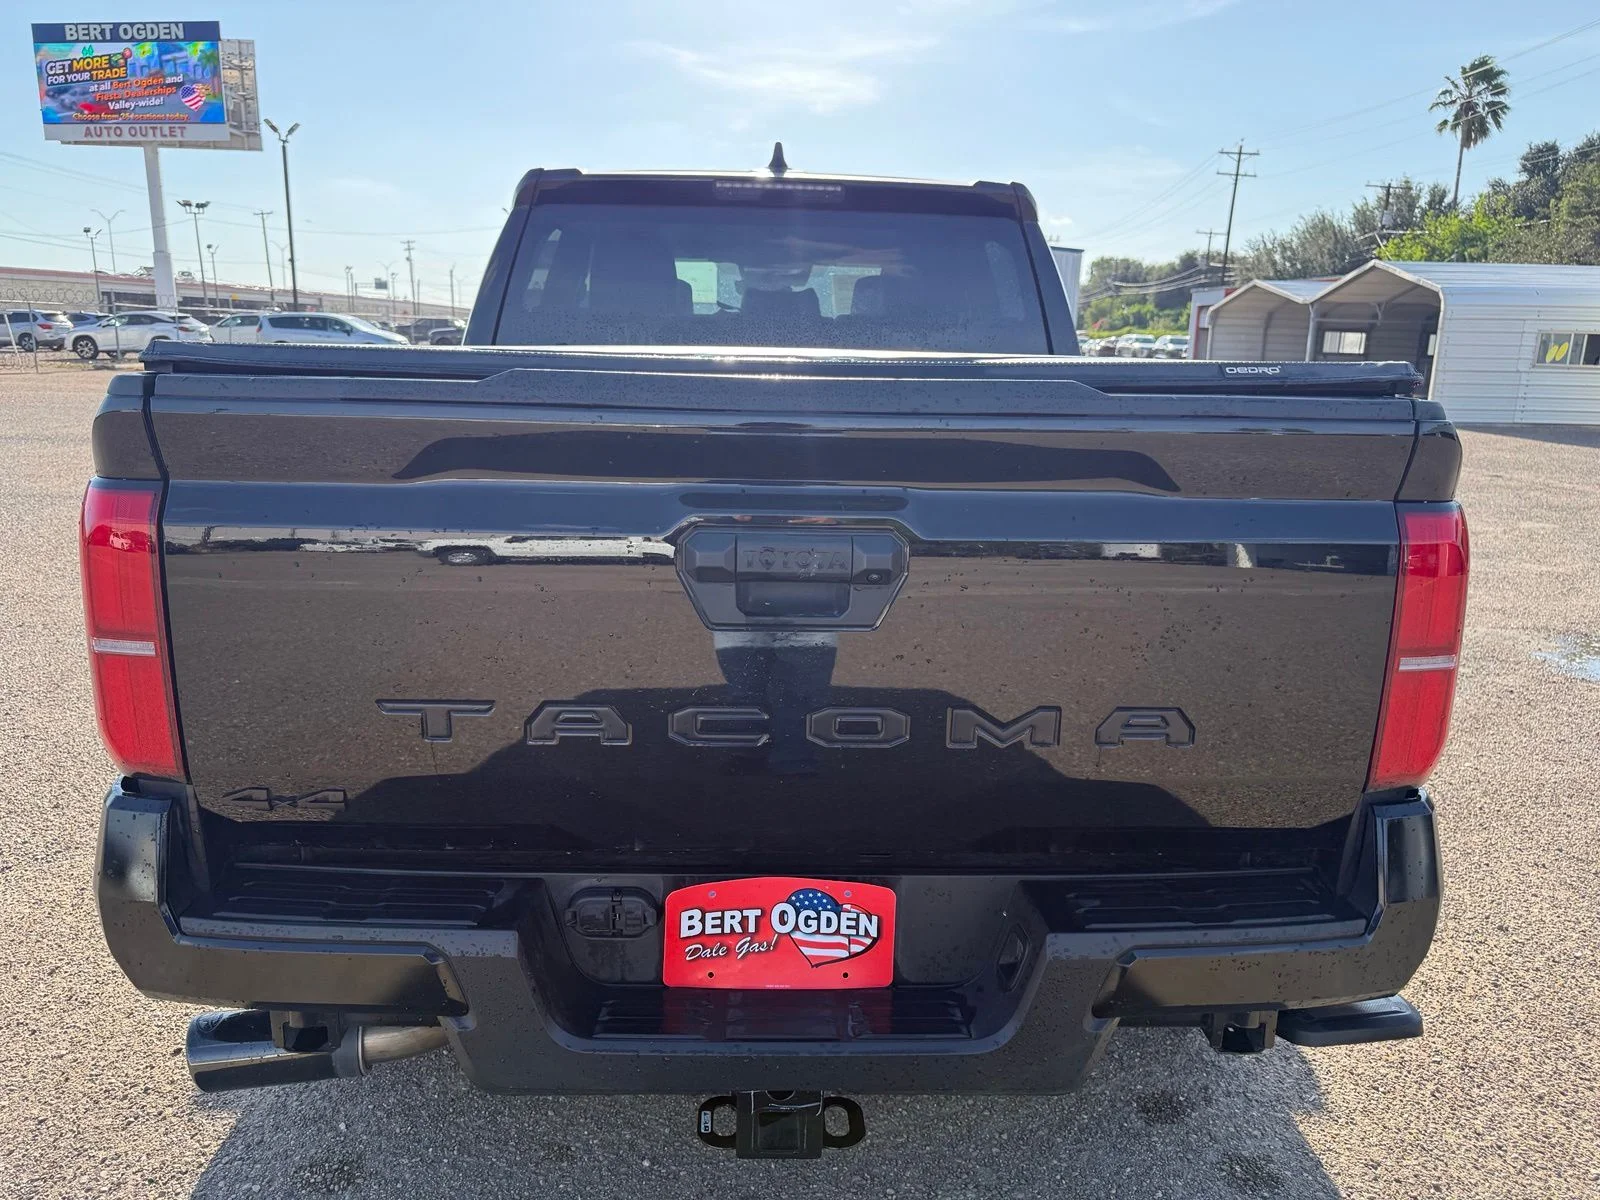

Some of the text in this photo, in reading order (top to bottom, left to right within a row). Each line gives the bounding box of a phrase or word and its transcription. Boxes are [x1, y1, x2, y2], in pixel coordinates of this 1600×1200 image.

[64, 23, 185, 41] BERT OGDEN
[46, 55, 110, 75] GET MORE
[47, 67, 127, 85] FOR YOUR TRADE
[89, 73, 184, 92] at all Bert Ogden and
[95, 85, 177, 101] Fiesta Dealerships
[108, 97, 164, 110] Valley-wide!
[84, 126, 187, 138] AUTO OUTLET
[1225, 366, 1281, 375] OEDRO
[375, 698, 1196, 749] TACOMA
[679, 902, 879, 939] BERT OGDEN
[685, 934, 779, 961] Dale Gas!
